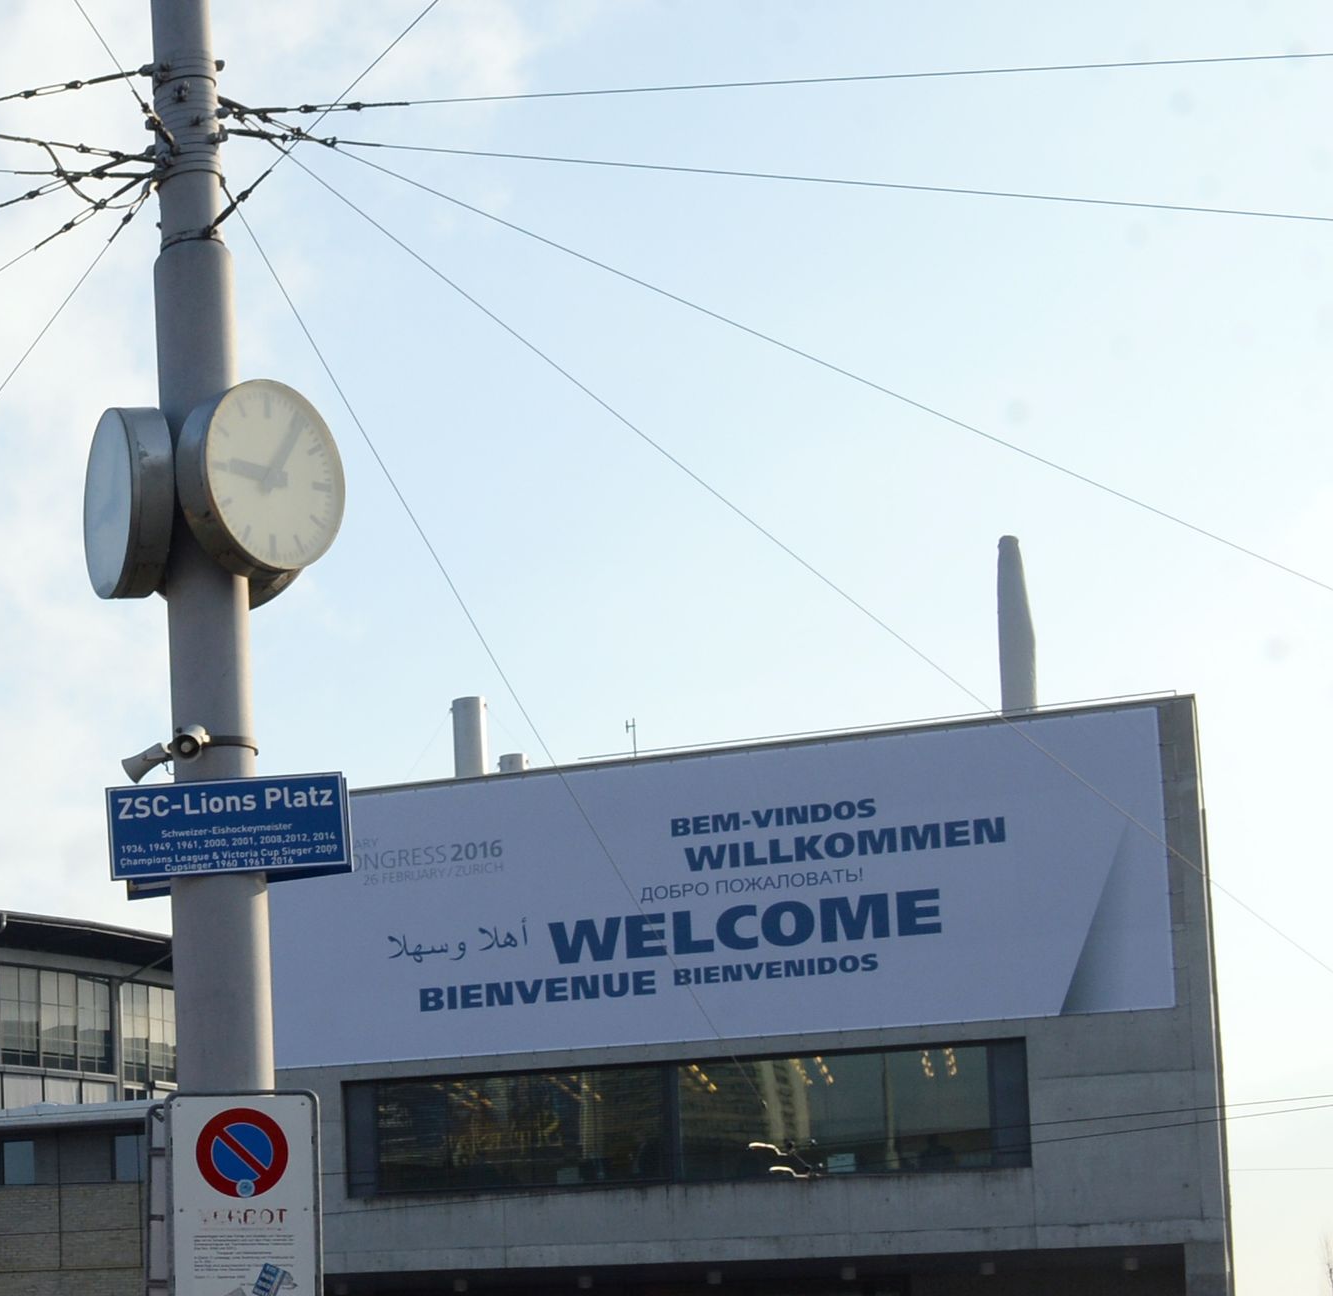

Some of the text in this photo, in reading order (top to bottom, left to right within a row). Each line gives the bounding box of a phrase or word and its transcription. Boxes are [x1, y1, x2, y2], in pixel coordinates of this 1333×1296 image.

[117, 786, 333, 819] ZSC-Lions Platz
[161, 823, 293, 839] Schweizer-Eishockeymeister
[670, 798, 877, 838] BEM-VINDOS
[149, 842, 174, 852] 1949,
[177, 840, 202, 850] 1961,
[204, 838, 229, 848] 2000,
[231, 836, 257, 846] 2001,
[313, 831, 336, 841] 2014
[450, 839, 503, 862] 2016
[683, 816, 1006, 872] WILLKOMMEN
[120, 855, 173, 868] Champions
[175, 854, 209, 864] League
[212, 851, 219, 860] &
[222, 848, 258, 859] Victoria
[260, 848, 279, 859] Cup
[282, 846, 313, 857] Sieger
[164, 861, 212, 872] Cupsieger
[363, 873, 379, 886] 26
[640, 867, 865, 904] ДОБРО ПОЖАЛОВАТЬ!
[547, 888, 943, 965] WELCOME
[419, 953, 879, 1013] BIENVENUE BIENVENIDOS
